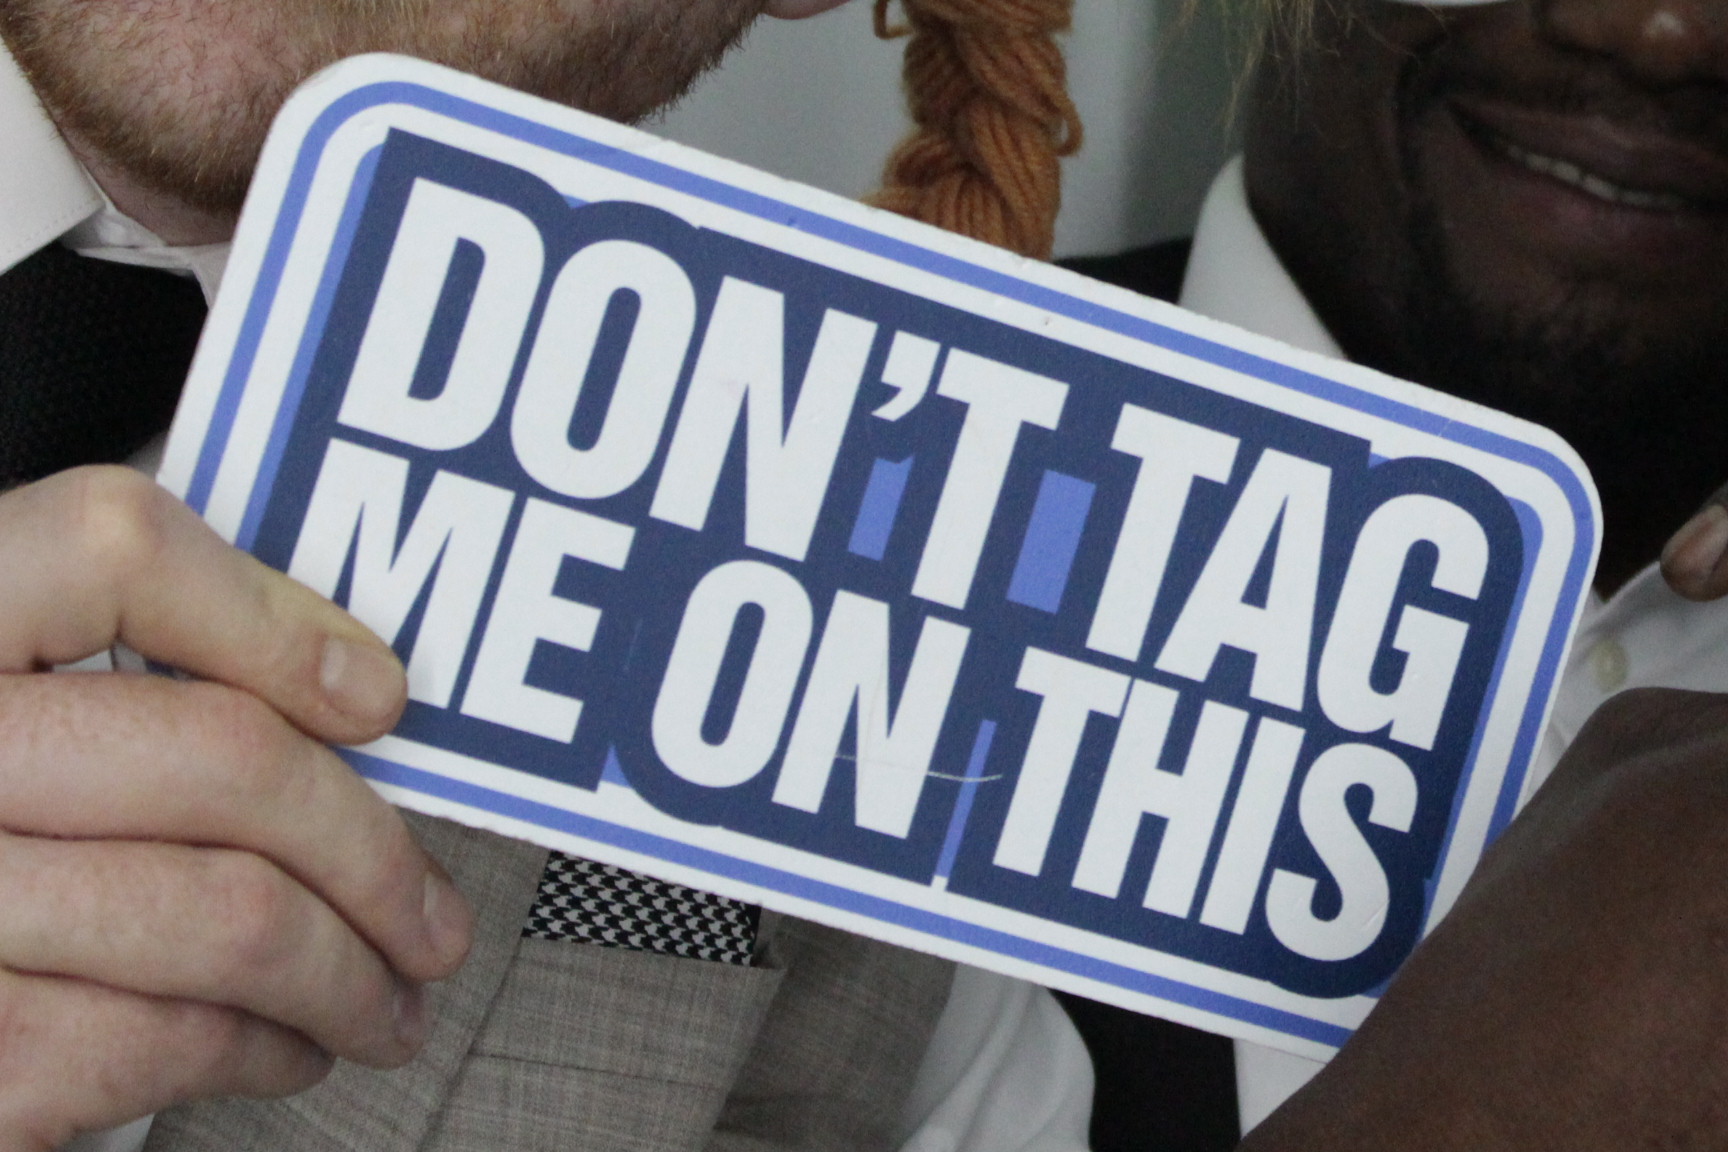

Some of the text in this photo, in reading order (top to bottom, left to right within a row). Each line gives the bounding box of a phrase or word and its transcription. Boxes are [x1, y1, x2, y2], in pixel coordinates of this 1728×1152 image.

[287, 437, 1418, 961] ME ON THIS
[337, 177, 1489, 751] DON'T TAG
